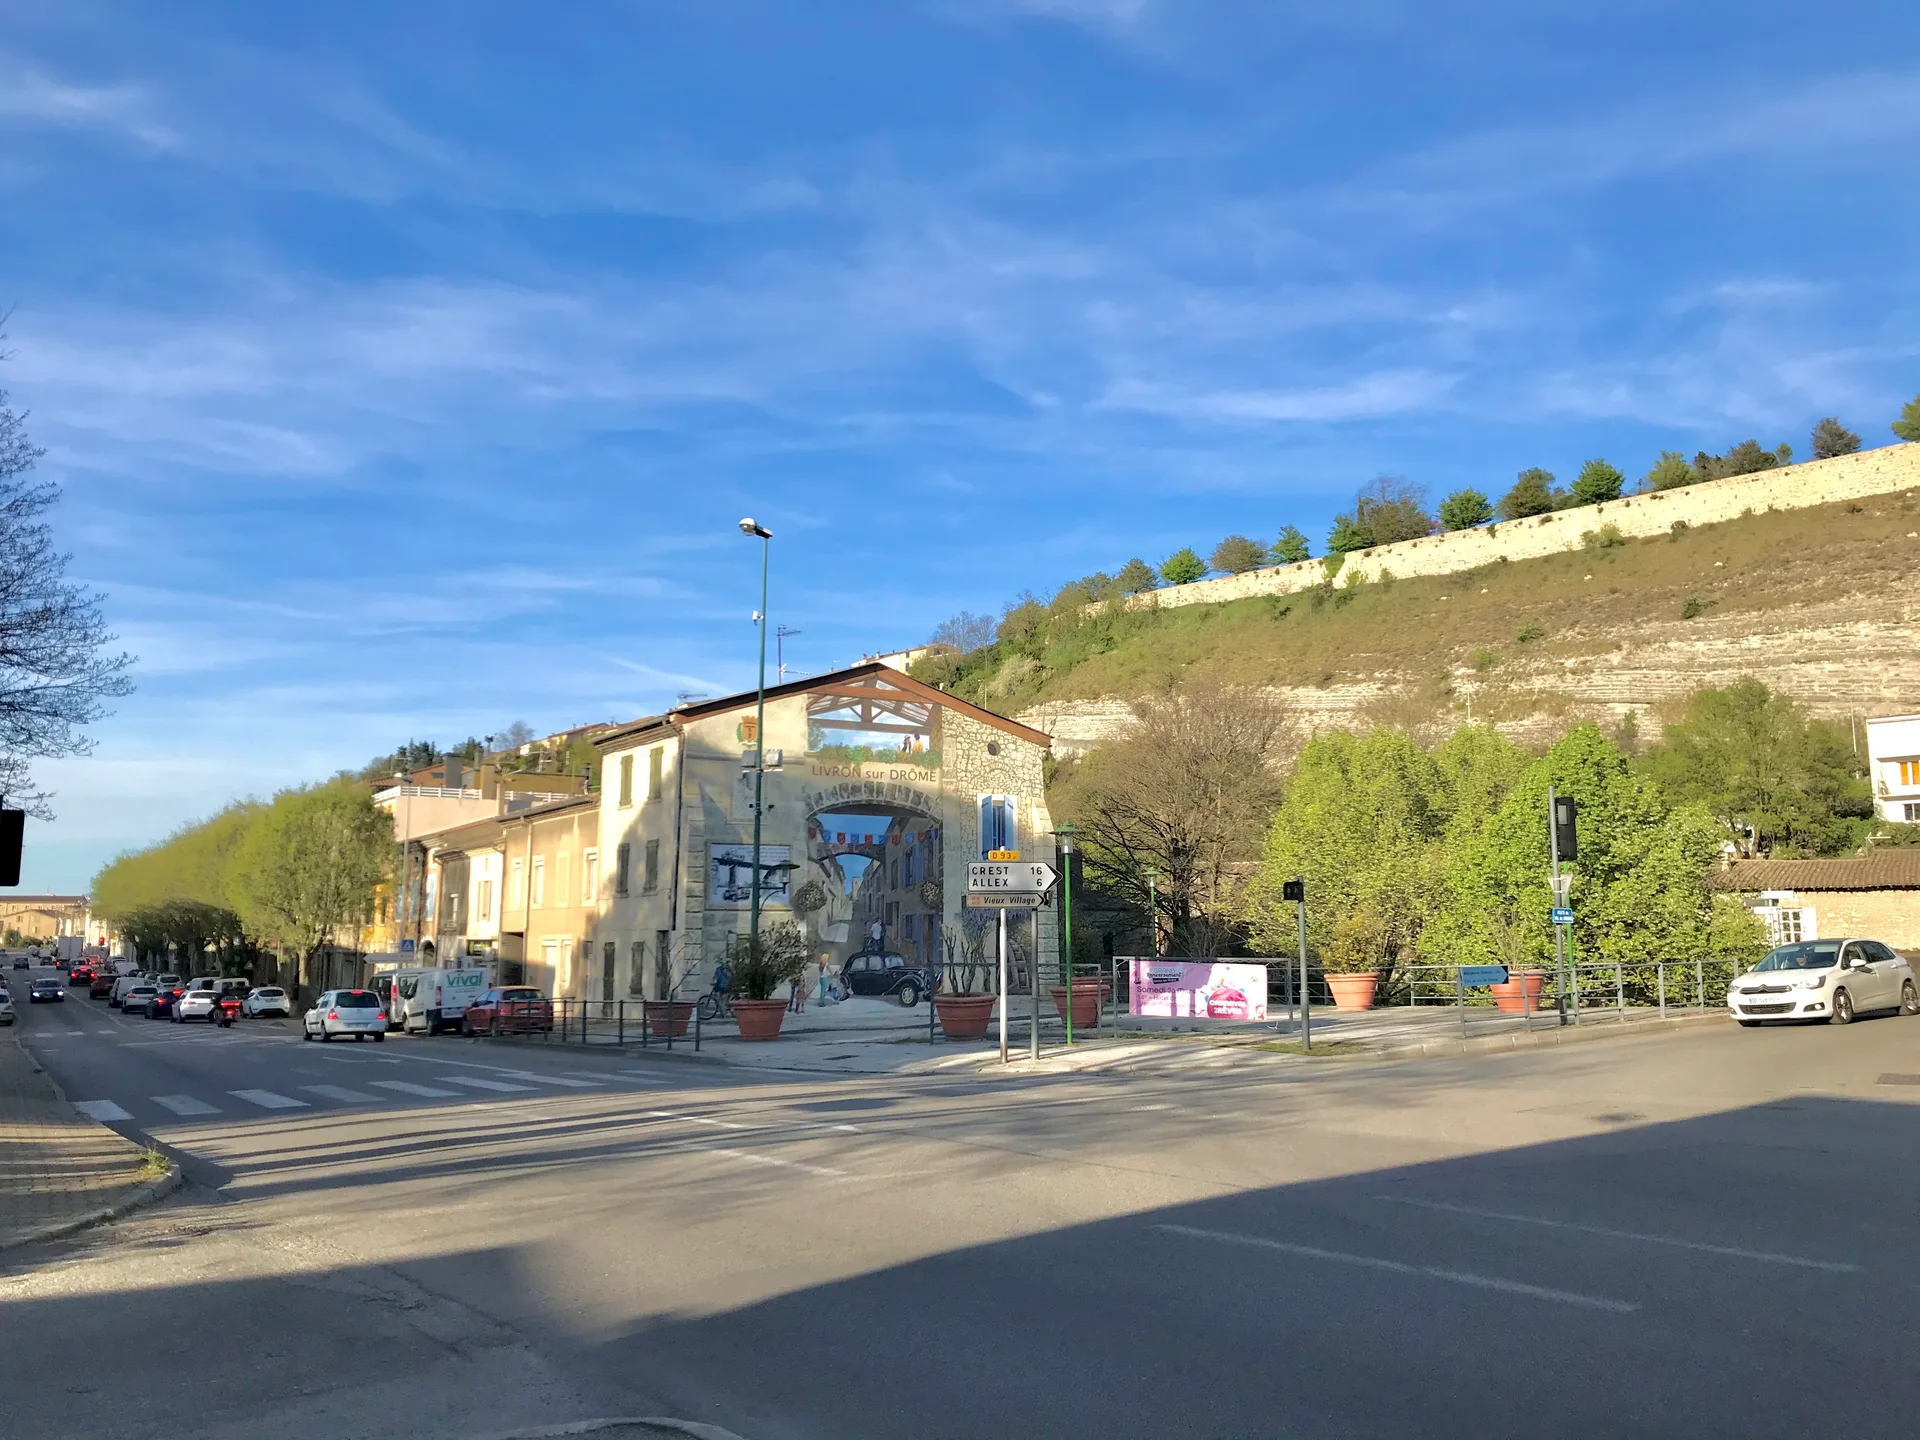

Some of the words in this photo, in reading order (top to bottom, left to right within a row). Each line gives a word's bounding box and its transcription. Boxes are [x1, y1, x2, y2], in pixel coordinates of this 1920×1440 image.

[812, 765, 861, 778] LIVRON
[865, 770, 885, 779] sur
[889, 768, 936, 782] DRÔME
[992, 852, 998, 860] D
[972, 866, 1009, 875] CREST
[1030, 866, 1043, 875] 16
[972, 878, 1009, 887] ALLEX
[1036, 878, 1043, 887] 6
[984, 896, 1005, 904] Vieux
[1009, 896, 1036, 905] Village
